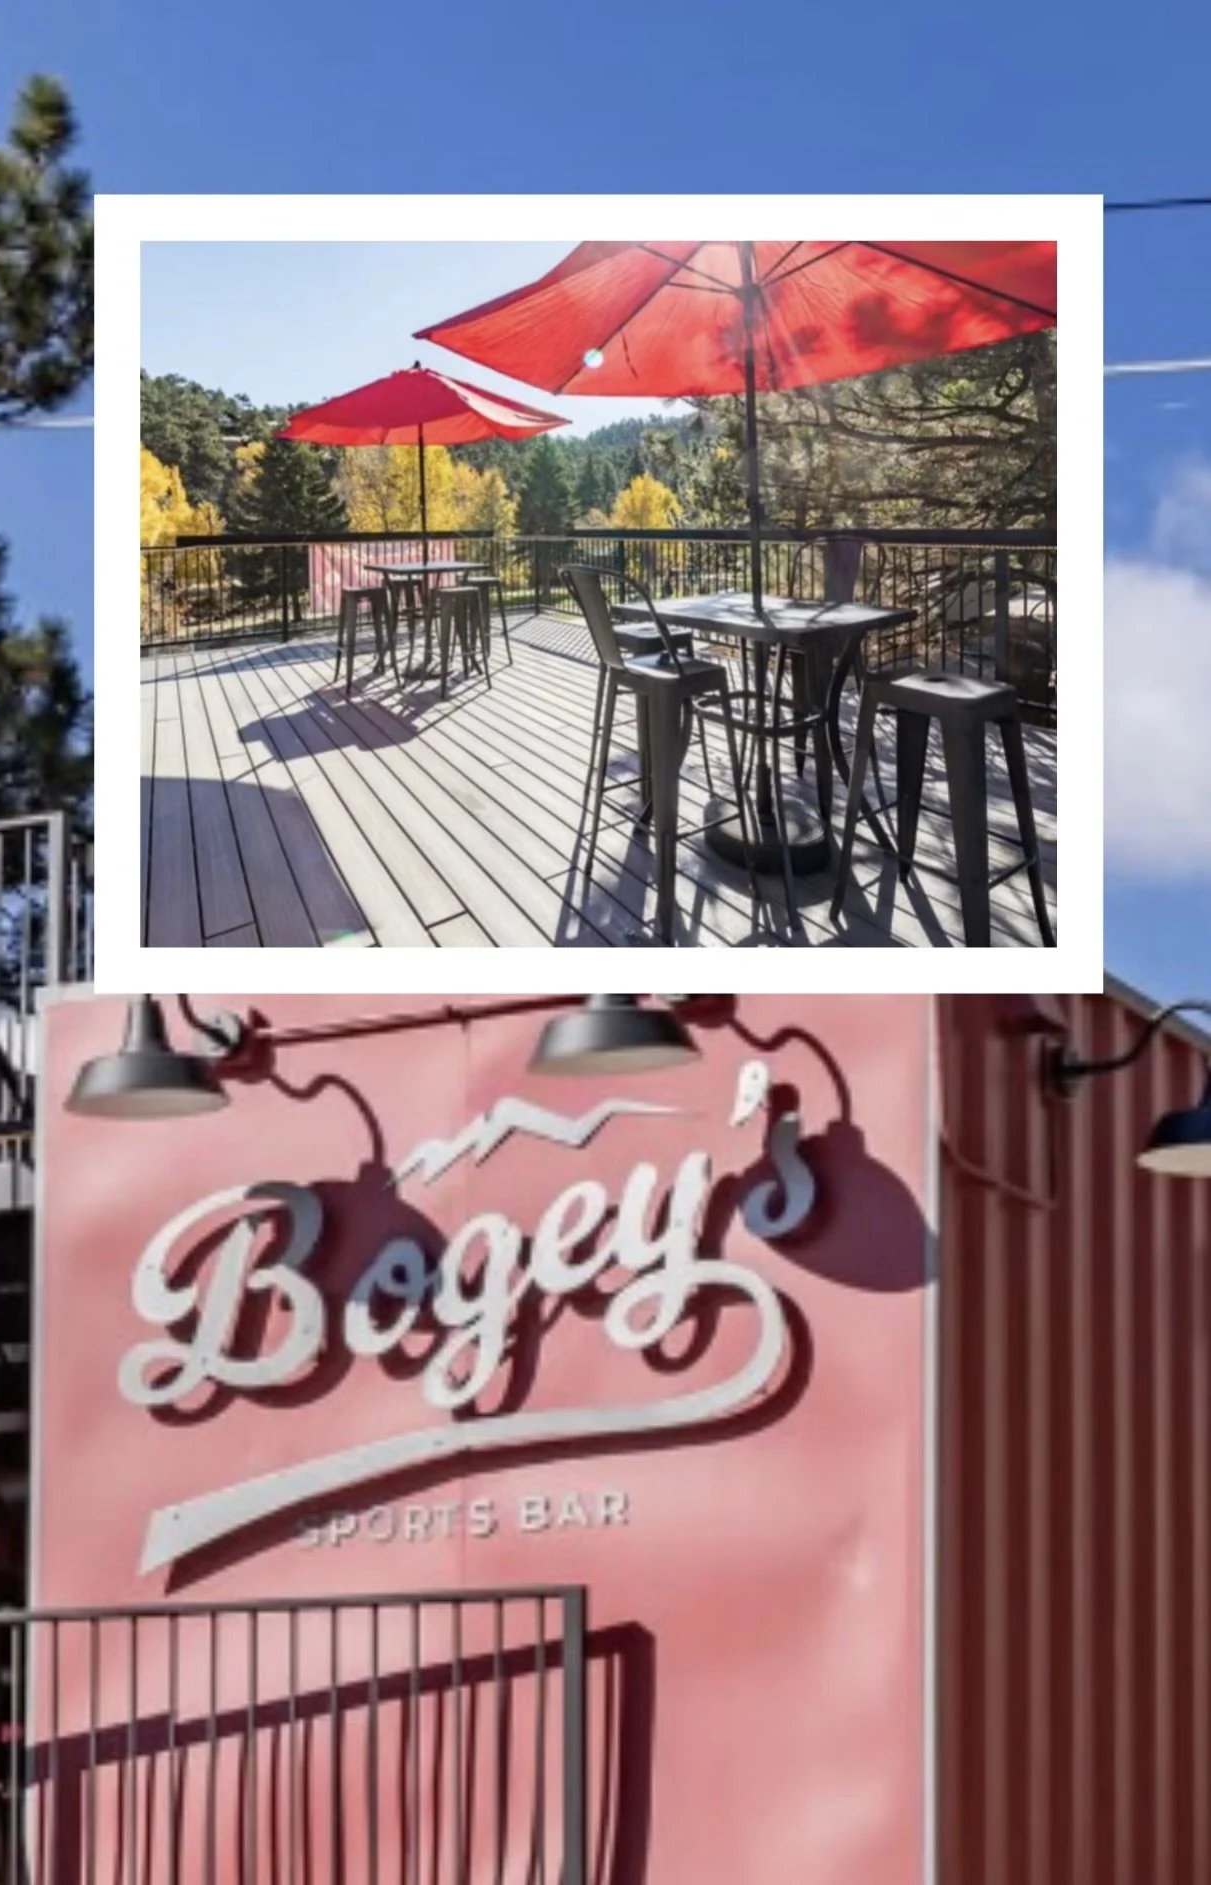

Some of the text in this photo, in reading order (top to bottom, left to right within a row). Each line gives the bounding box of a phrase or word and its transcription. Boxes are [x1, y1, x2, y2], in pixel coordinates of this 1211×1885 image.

[118, 1060, 817, 1410] Bogey's
[299, 1489, 630, 1548] SPORTS BAR
